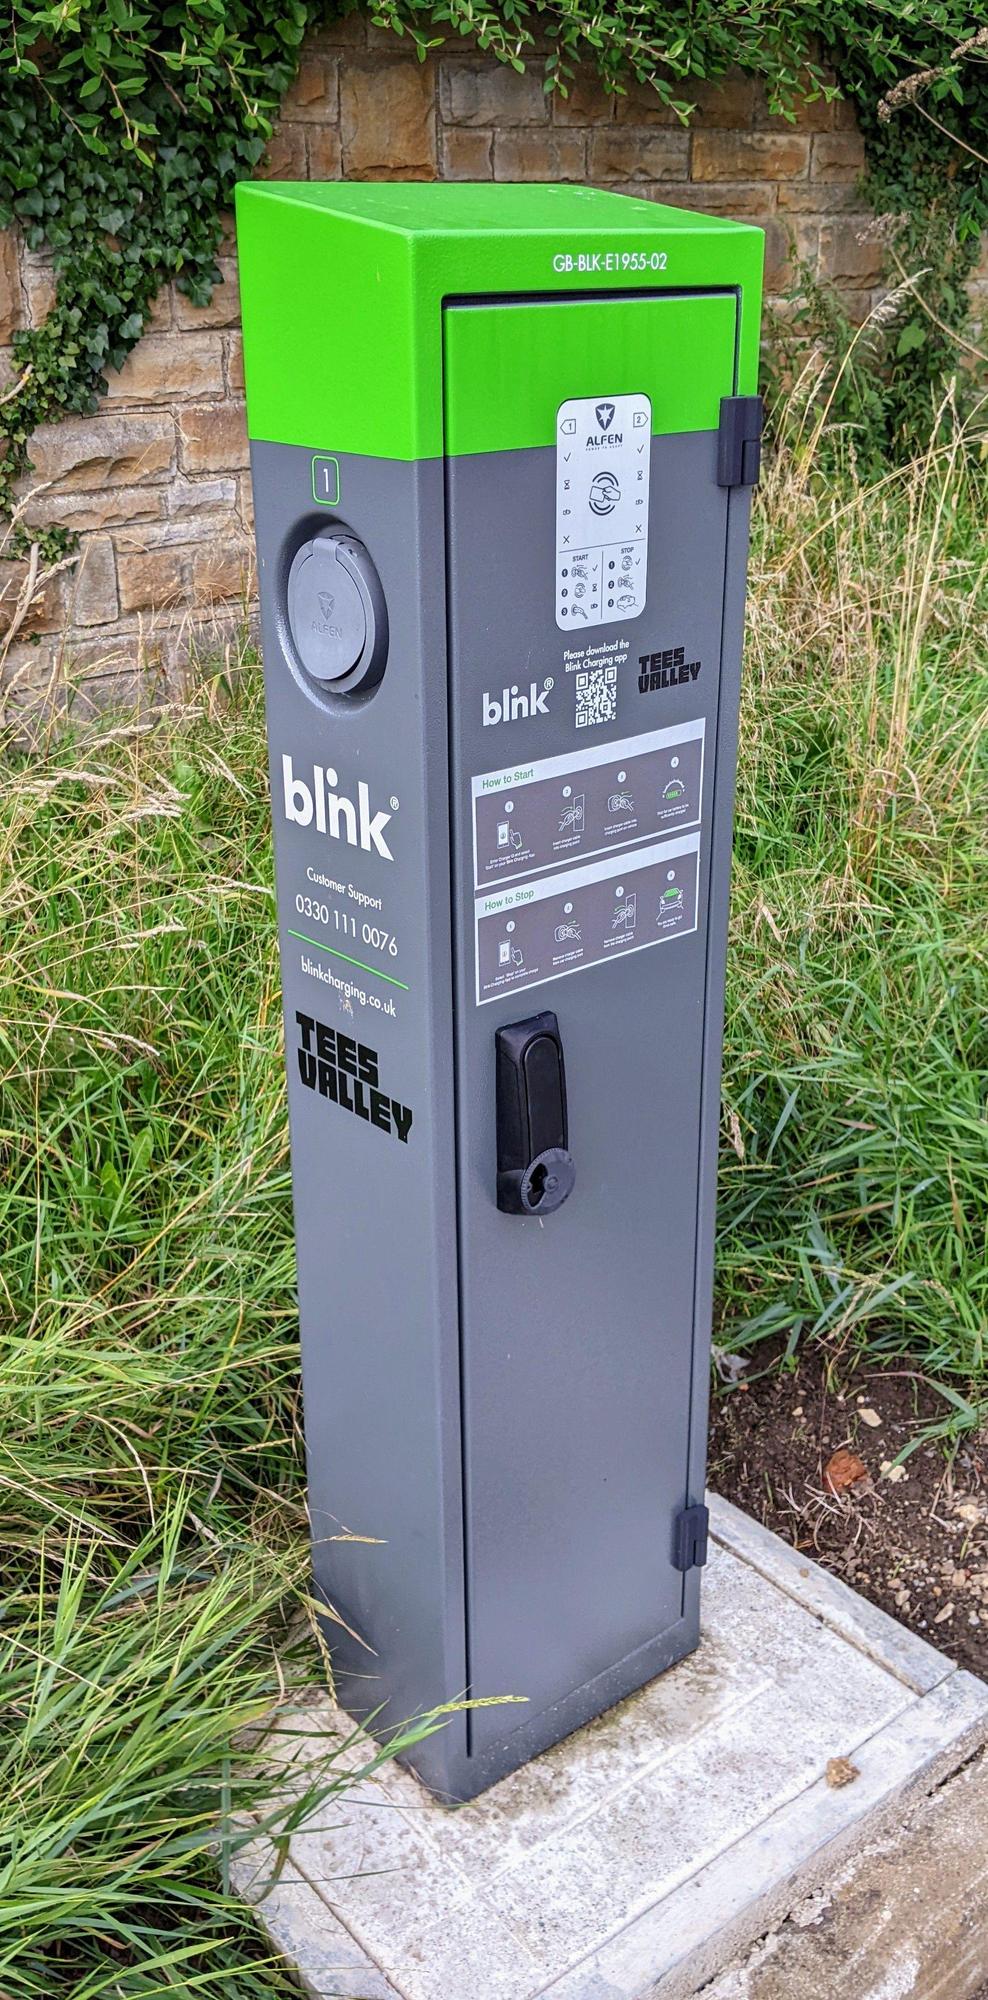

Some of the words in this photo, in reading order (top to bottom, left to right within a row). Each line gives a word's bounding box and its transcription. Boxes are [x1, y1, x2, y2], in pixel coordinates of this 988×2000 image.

[553, 252, 668, 272] GB-BLK-E1955-02
[586, 433, 623, 447] ALFEN
[323, 468, 329, 493] 1
[572, 554, 589, 562] START
[311, 620, 343, 640] ALFEN
[563, 650, 584, 661] Please
[586, 641, 618, 656] download
[620, 639, 630, 650] the
[638, 647, 685, 674] TEES
[565, 660, 581, 672] Blink
[582, 656, 613, 669] Charging
[614, 654, 627, 665] app
[638, 661, 702, 694] VALLEY
[482, 778, 501, 789] How
[503, 775, 512, 784] to
[514, 769, 534, 781] Start
[306, 867, 346, 894] Customer
[348, 884, 382, 911] Support
[485, 899, 503, 911] How
[505, 896, 513, 904] to
[515, 890, 534, 902] Stop
[295, 894, 329, 924] 0330
[334, 910, 356, 938] 111
[362, 924, 398, 956] 0076
[301, 955, 397, 1018] blinkcharging.co.uk
[295, 1010, 379, 1089] TEES
[298, 1048, 413, 1144] VALLEY
